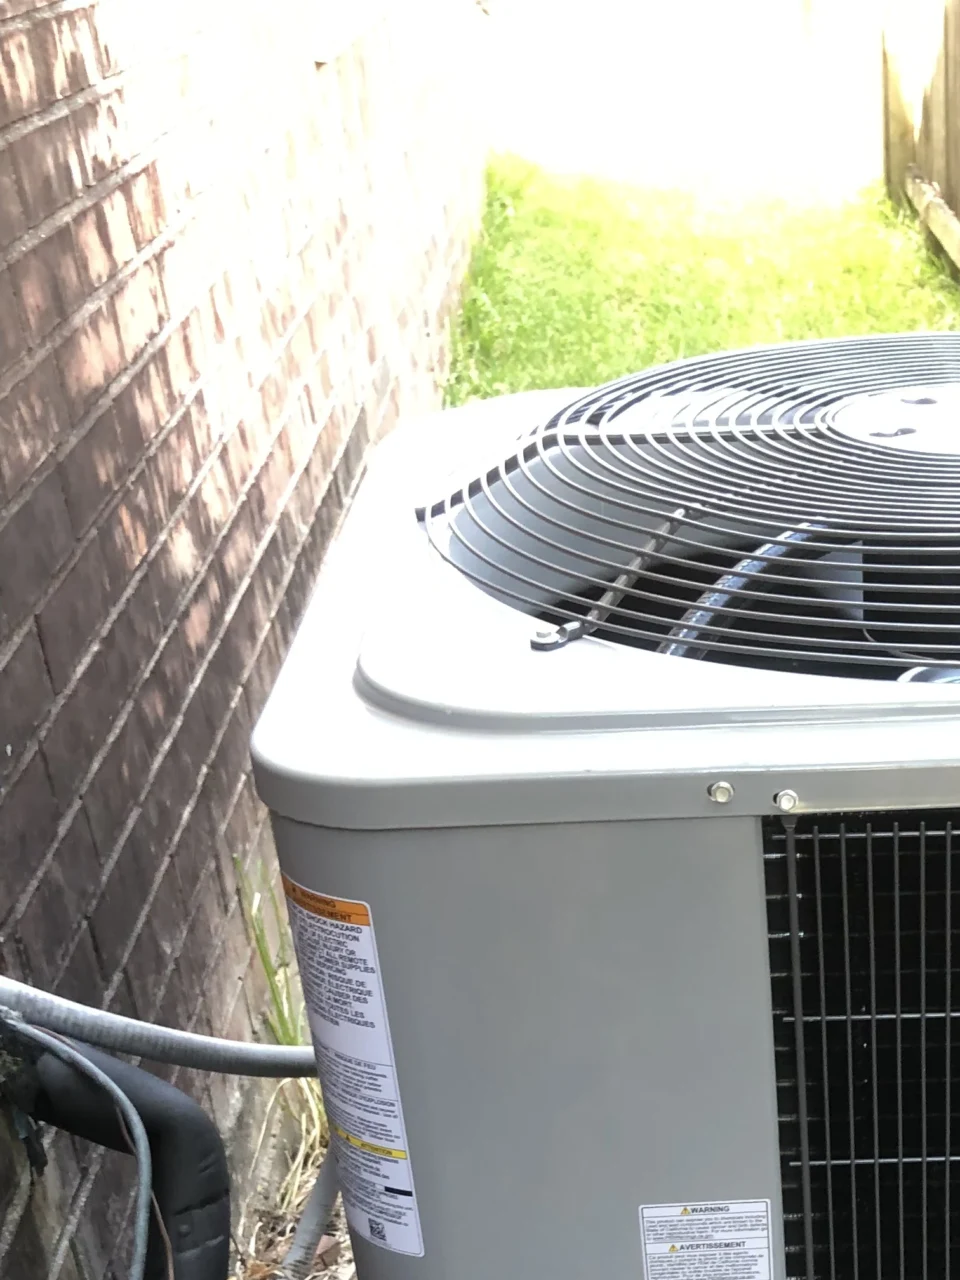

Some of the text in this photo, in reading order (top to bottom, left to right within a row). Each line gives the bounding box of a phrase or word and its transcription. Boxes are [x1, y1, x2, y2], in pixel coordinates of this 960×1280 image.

[329, 922, 363, 934] HAZARD
[690, 1205, 730, 1214] WARNING
[679, 1240, 747, 1251] AVERTISSEMENT
